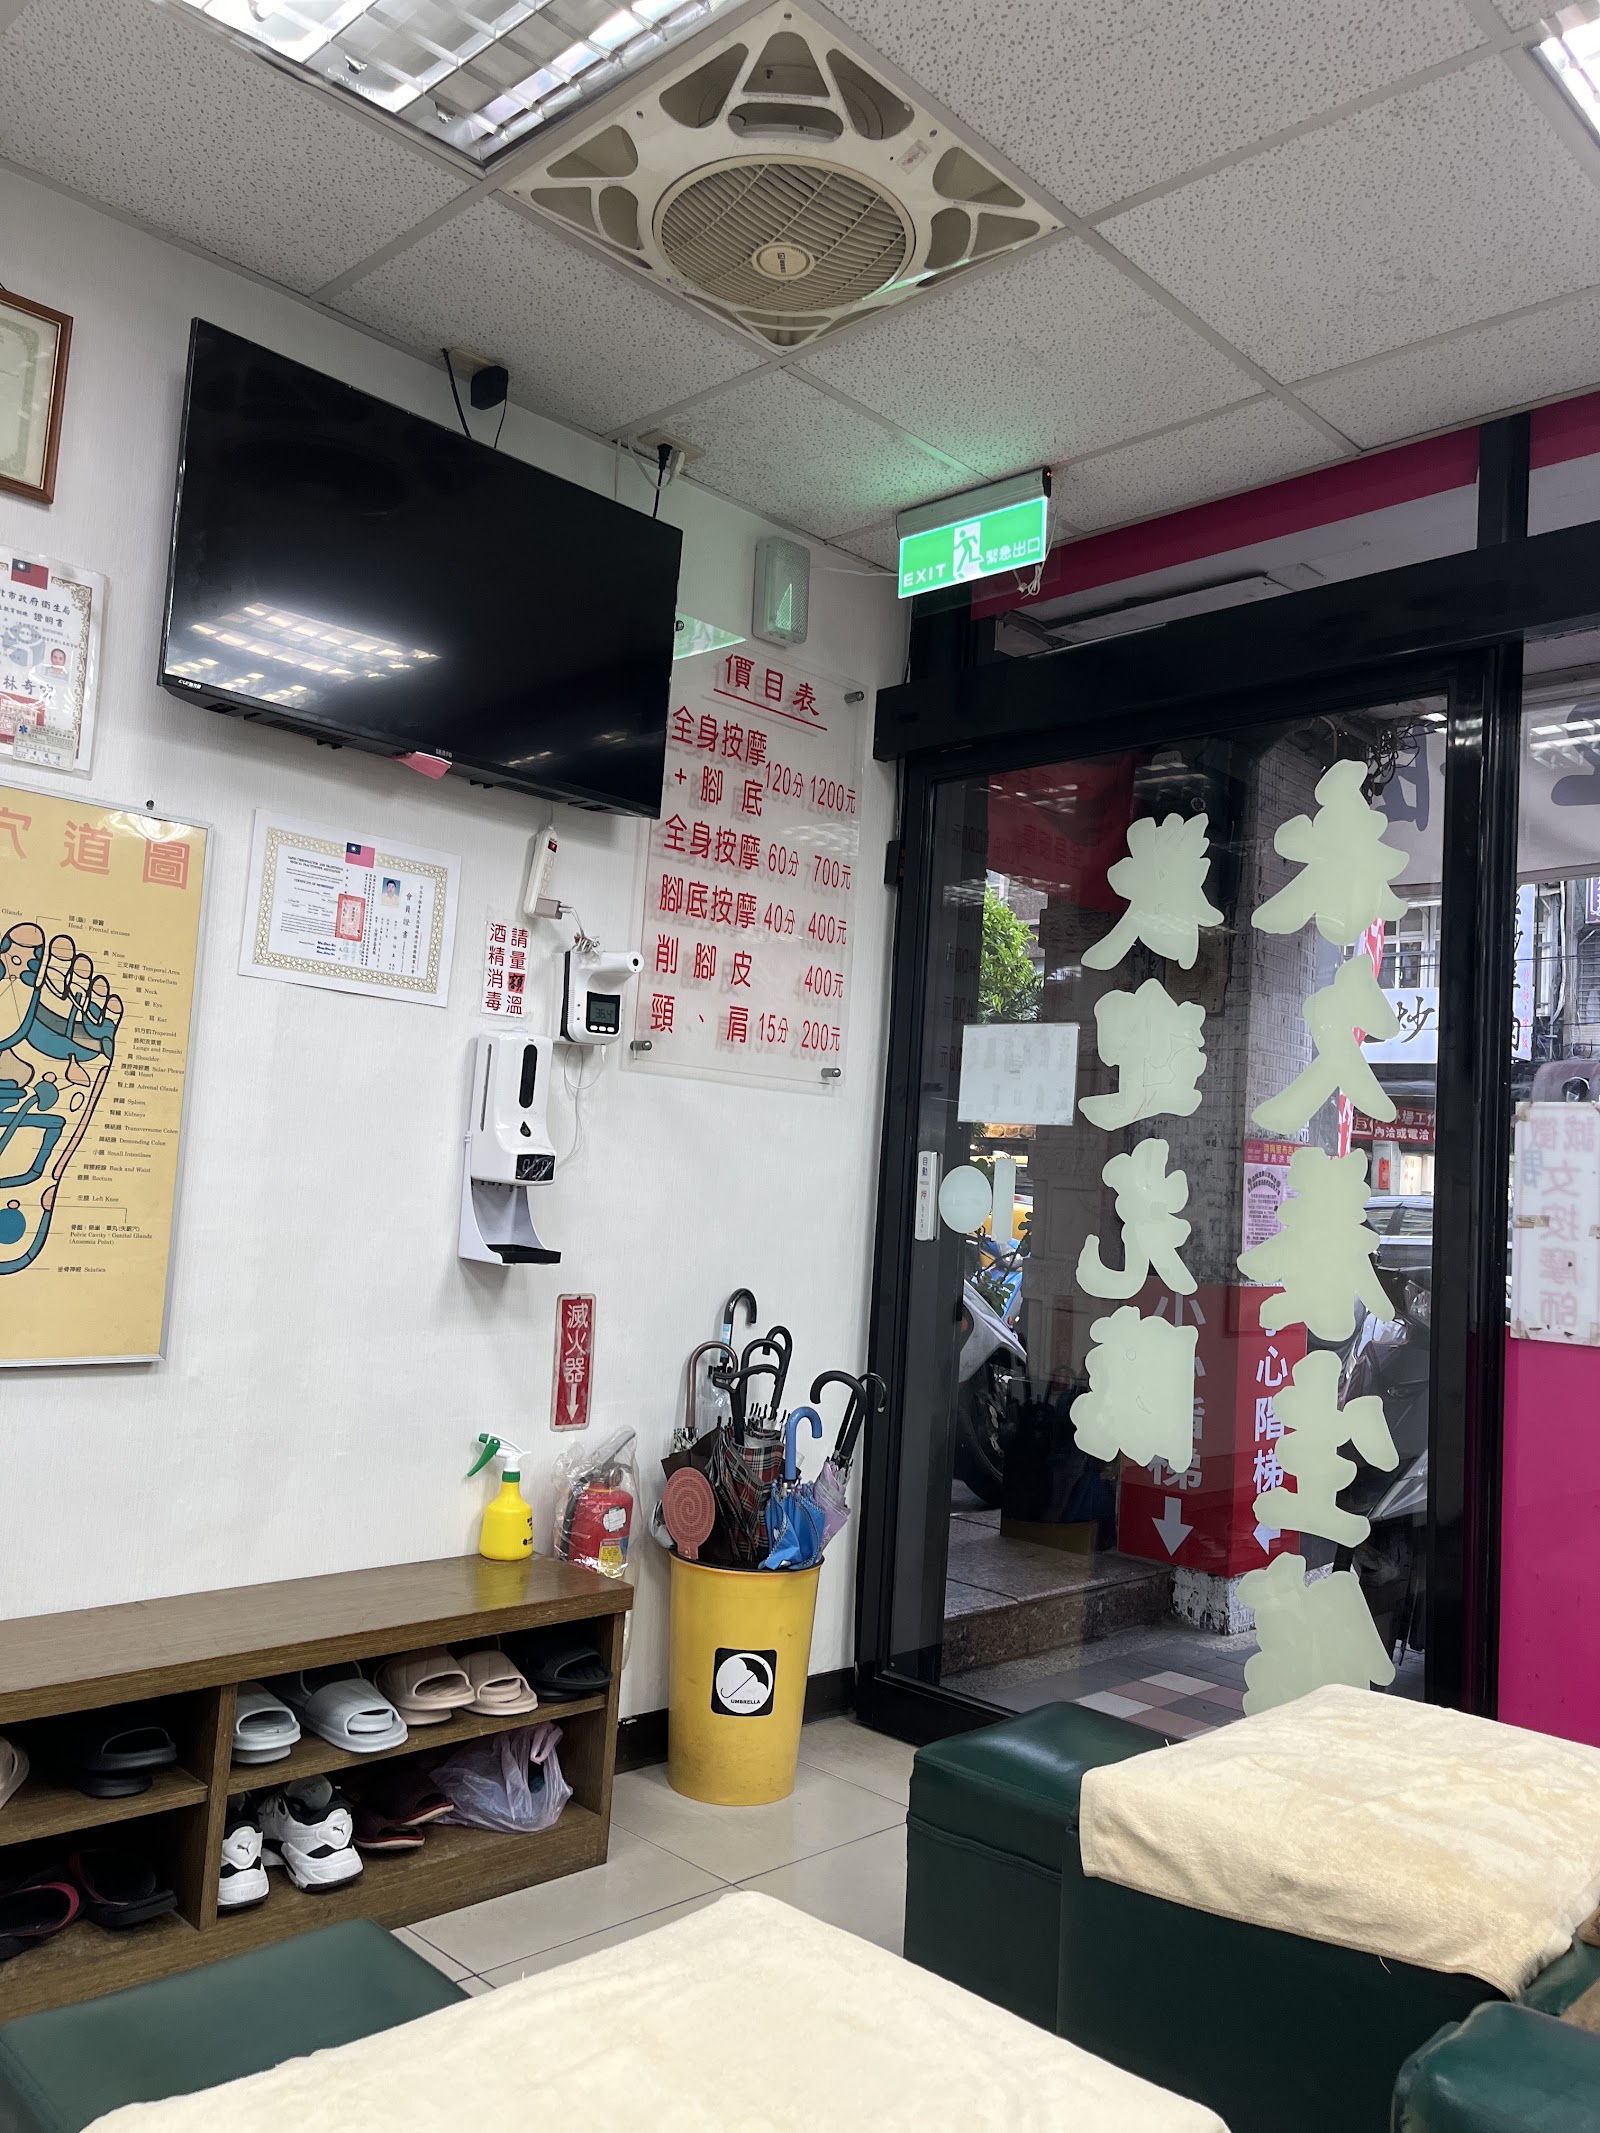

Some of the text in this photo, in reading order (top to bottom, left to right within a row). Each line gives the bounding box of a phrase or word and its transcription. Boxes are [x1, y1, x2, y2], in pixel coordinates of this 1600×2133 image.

[903, 563, 947, 588] EXIT
[986, 536, 1041, 566] 緊急出口
[725, 654, 820, 716] 價目表
[671, 705, 768, 767] 全身按摩
[765, 761, 857, 814] 120分 1200元
[664, 813, 852, 890] 全身按摩 60分 700元
[659, 873, 847, 945] 腳底按摩 40分 400元
[484, 922, 507, 1012] 酒精消毒
[506, 927, 529, 1016] 請量額溫
[655, 934, 844, 998] 削腳皮 400元
[135, 1054, 160, 1062] Shoulder
[759, 1012, 789, 1043] 15分
[801, 1020, 841, 1052] 200元
[123, 1110, 146, 1119] Kidneys
[565, 1303, 589, 1383] 滅火器
